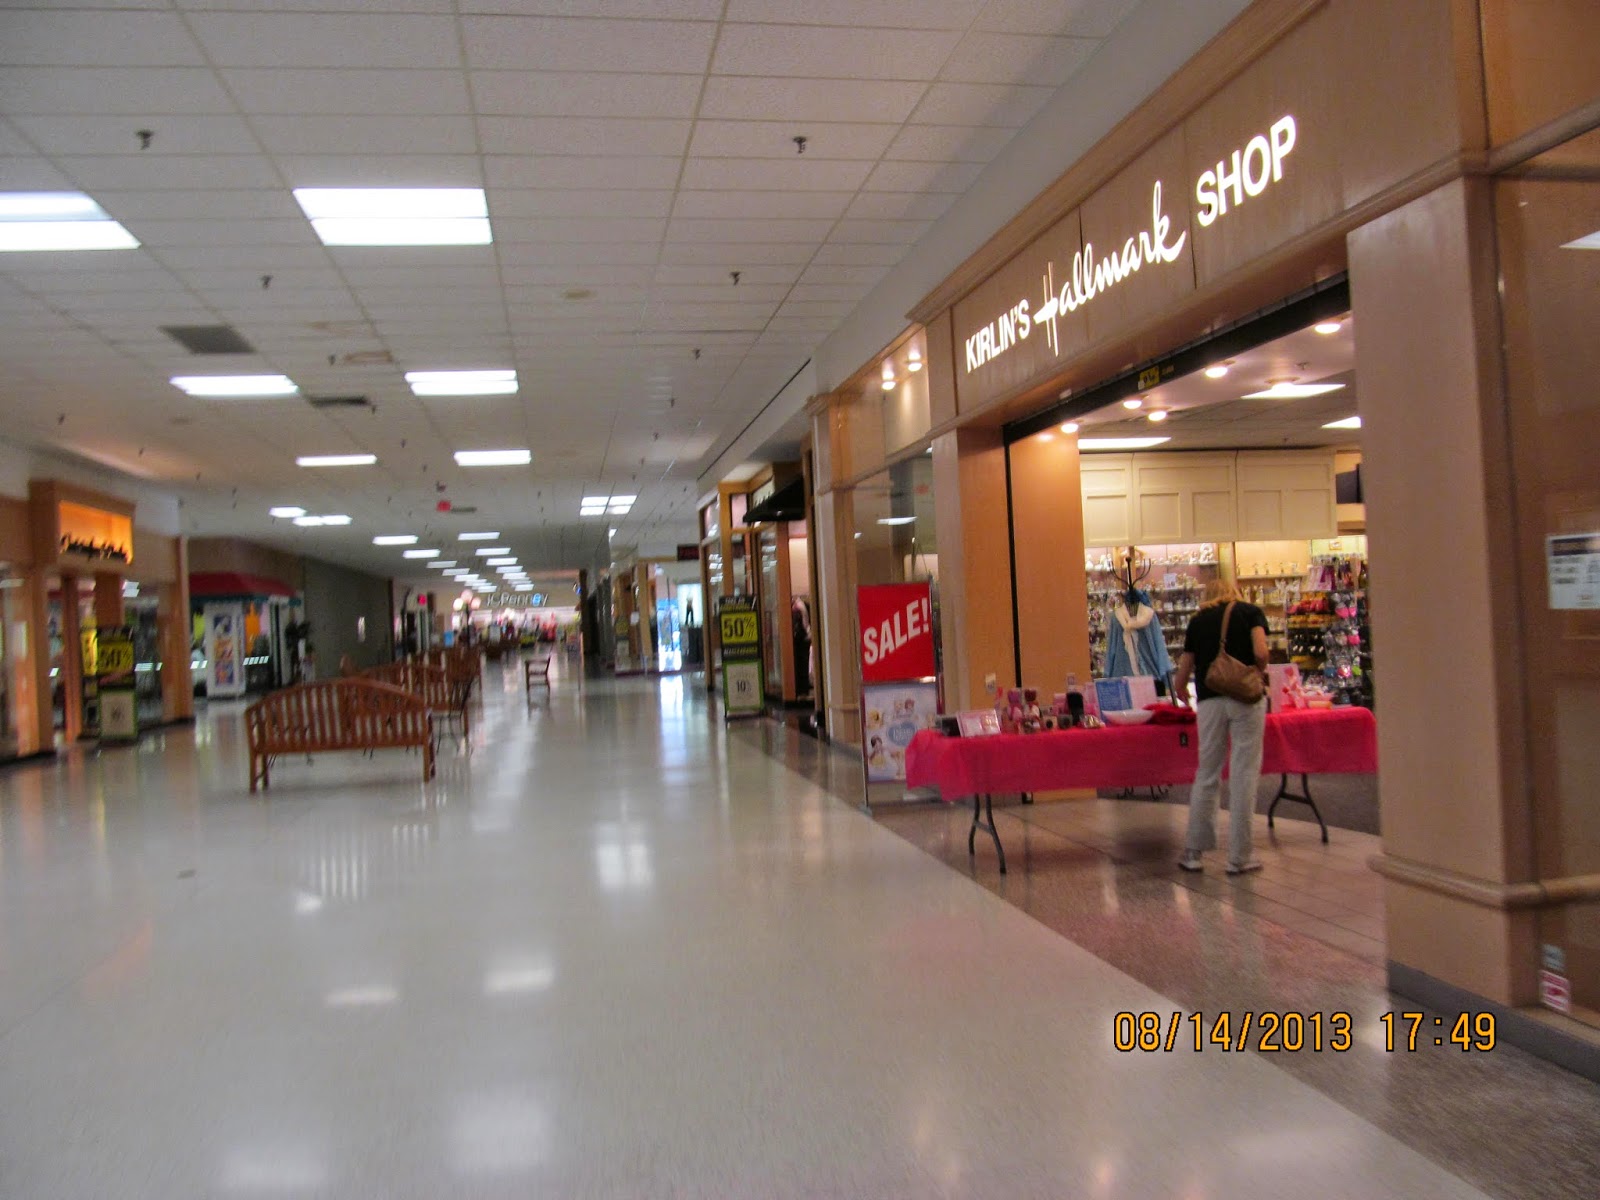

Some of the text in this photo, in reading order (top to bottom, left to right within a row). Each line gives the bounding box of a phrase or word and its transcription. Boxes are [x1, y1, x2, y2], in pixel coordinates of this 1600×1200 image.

[965, 115, 1297, 373] KIRLIN'S Hallmark SHOP
[863, 597, 930, 666] SALE!
